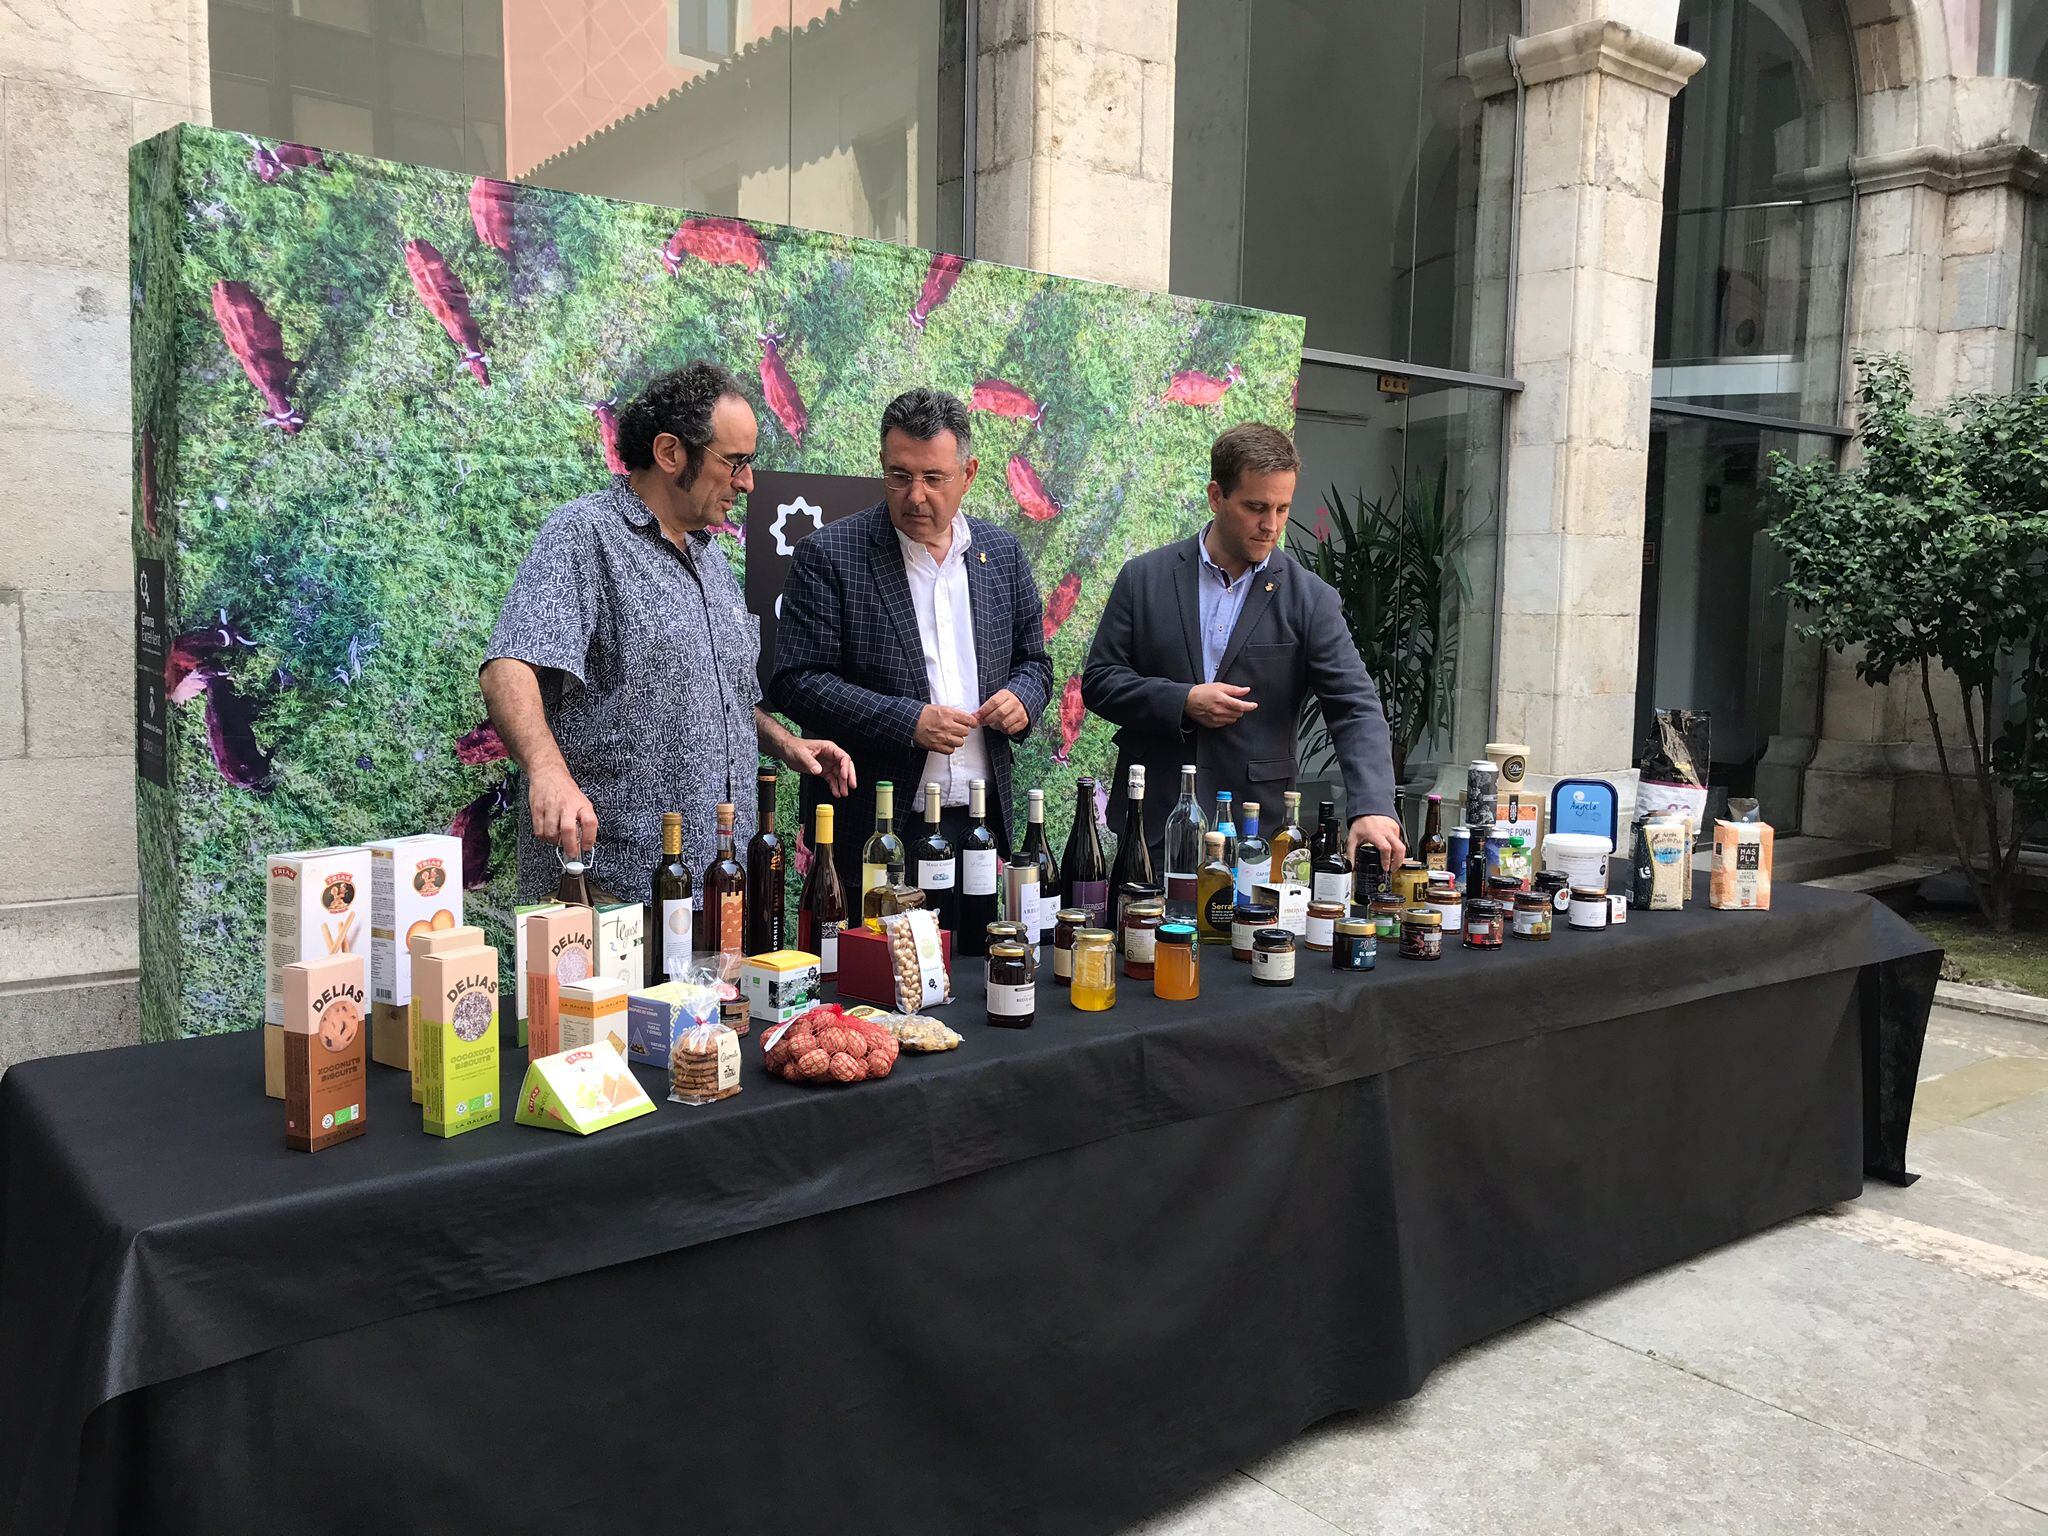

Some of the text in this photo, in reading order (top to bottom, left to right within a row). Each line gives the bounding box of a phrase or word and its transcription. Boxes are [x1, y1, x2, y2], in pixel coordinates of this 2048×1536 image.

[418, 860, 441, 869] TRIAS
[273, 868, 295, 879] TRIAS
[327, 875, 351, 883] TRIAS
[552, 932, 593, 958] DELIAS
[446, 974, 498, 1002] DELIAS
[312, 983, 364, 1013] DELIAS
[566, 1052, 592, 1064] TRIAS
[529, 1087, 540, 1112] TRIAS
[466, 1113, 494, 1126] GALETA
